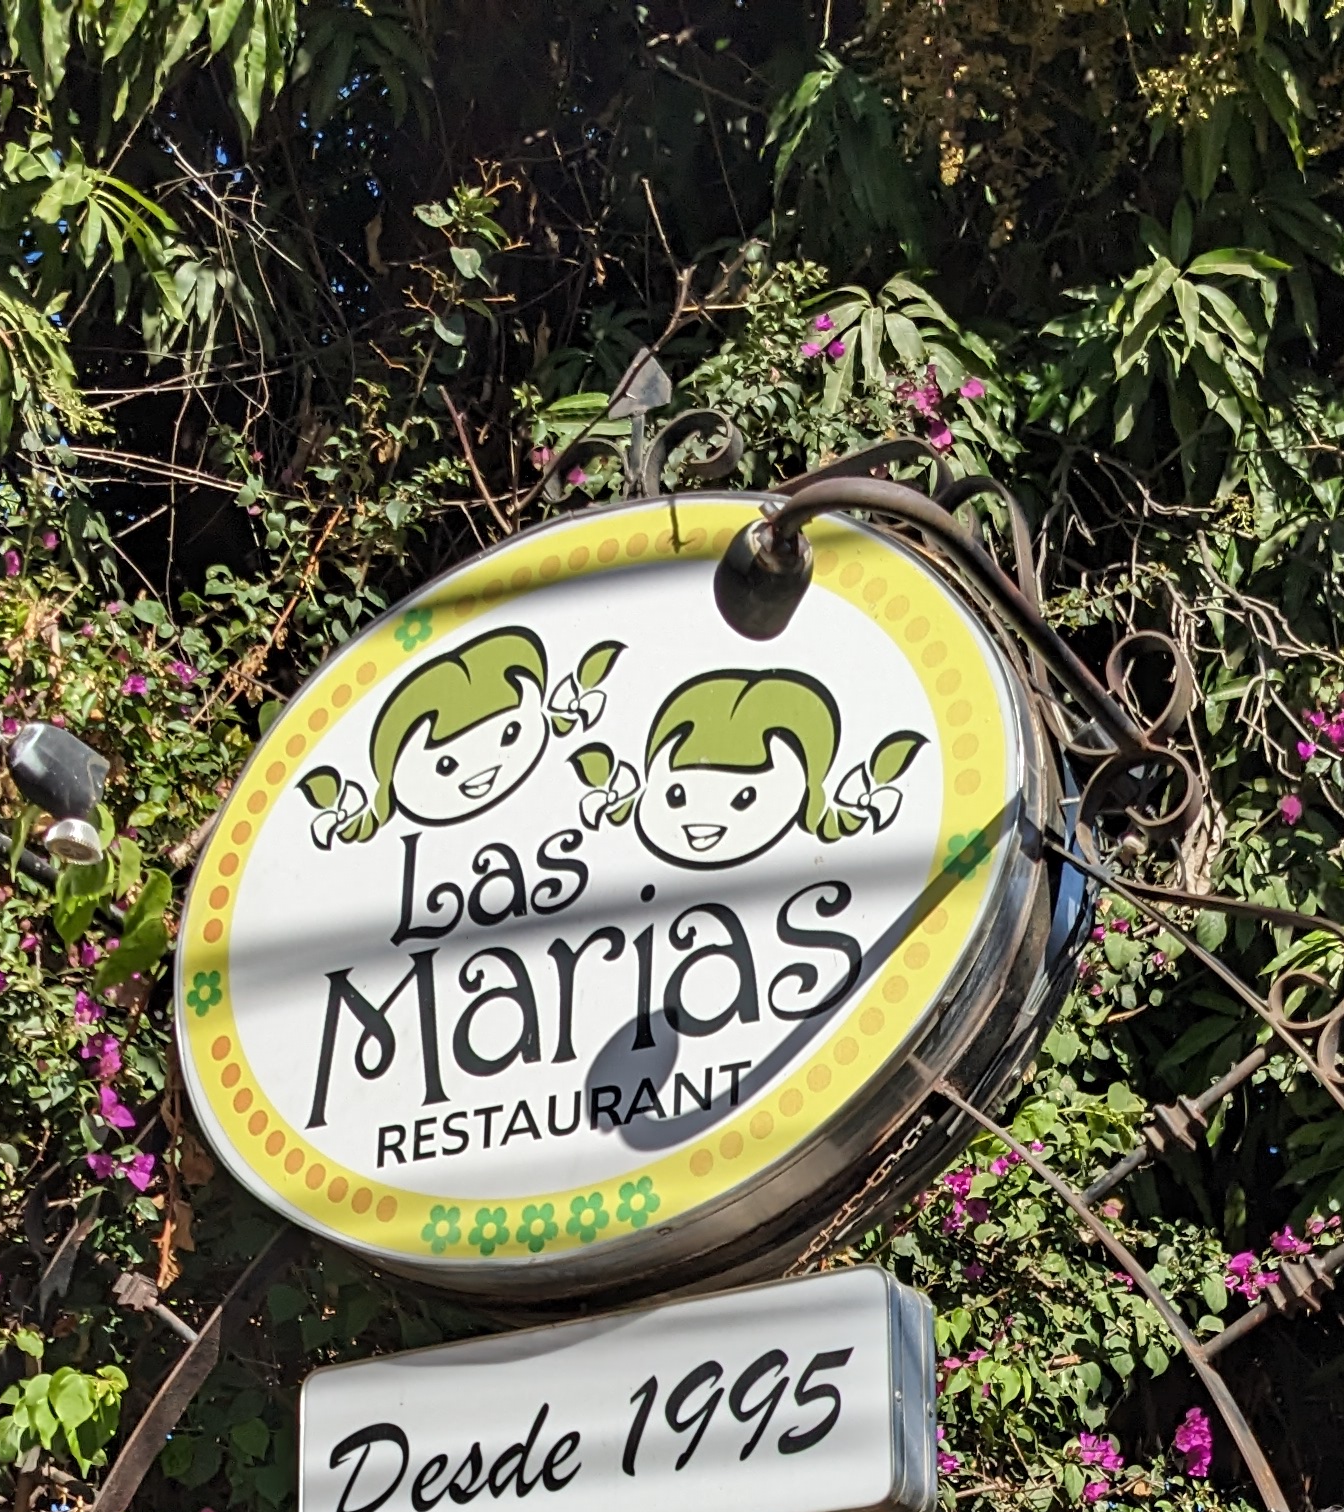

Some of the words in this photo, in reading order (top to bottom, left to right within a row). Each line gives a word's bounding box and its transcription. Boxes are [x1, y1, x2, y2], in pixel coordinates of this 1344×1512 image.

[391, 828, 590, 947] Las
[306, 879, 862, 1131] Marias
[375, 1060, 753, 1169] RESTAURANT
[621, 1346, 854, 1477] 1995
